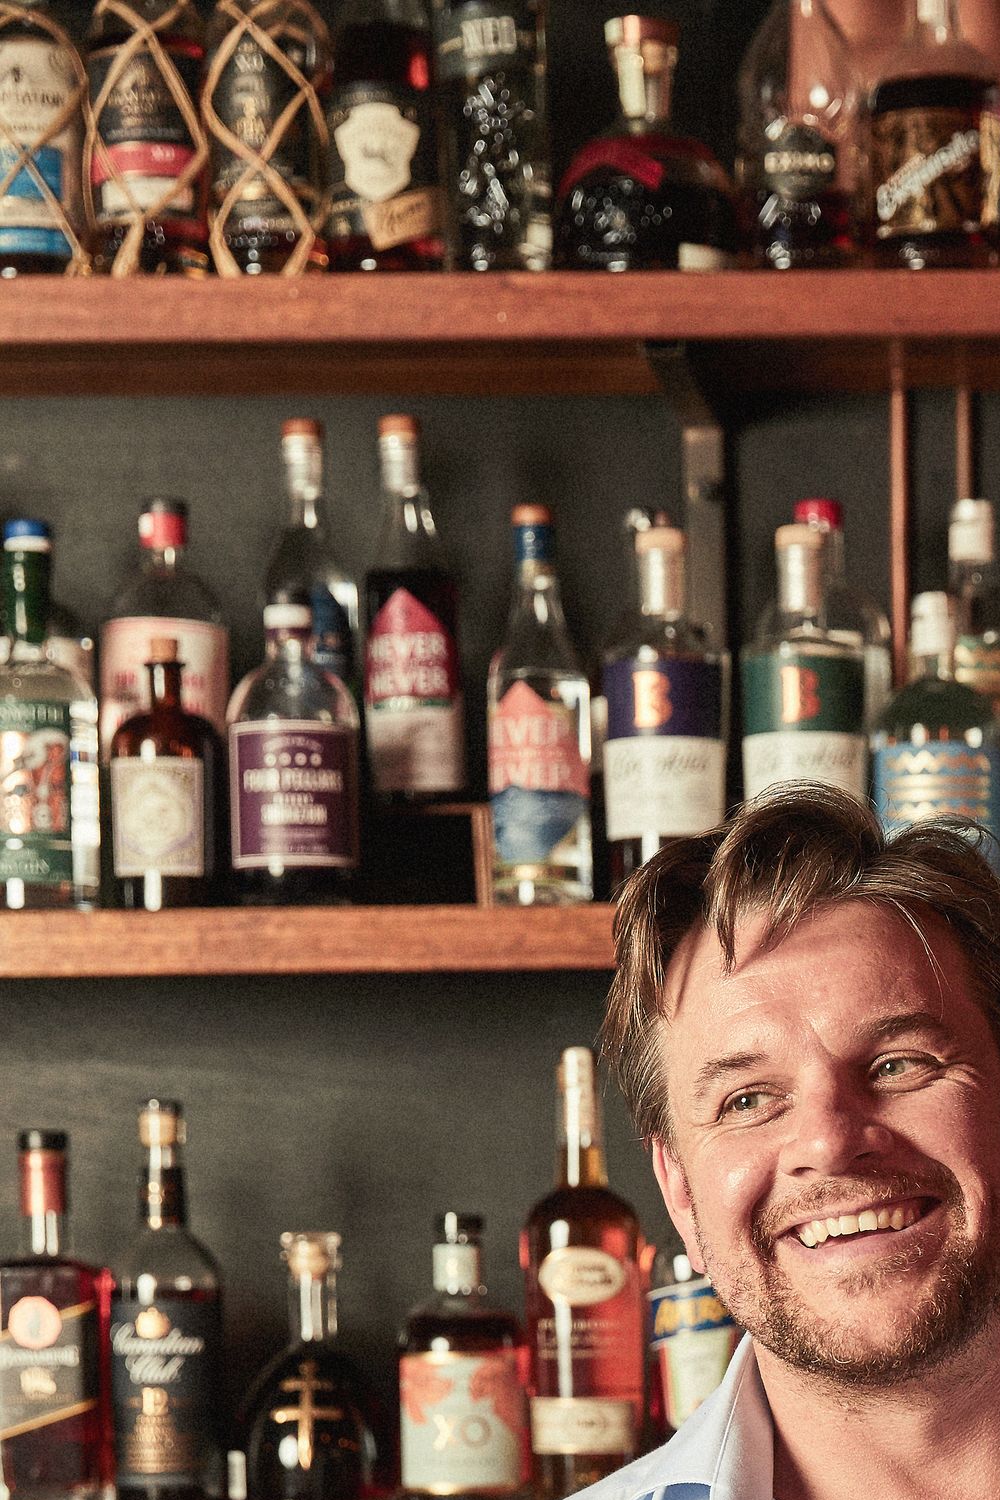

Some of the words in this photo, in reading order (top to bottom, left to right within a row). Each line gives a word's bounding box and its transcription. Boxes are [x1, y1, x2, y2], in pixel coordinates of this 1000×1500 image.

[370, 631, 449, 661] NEVER
[370, 667, 450, 696] NEVER
[633, 670, 674, 729] B
[781, 664, 821, 724] B
[432, 1413, 494, 1451] XO
